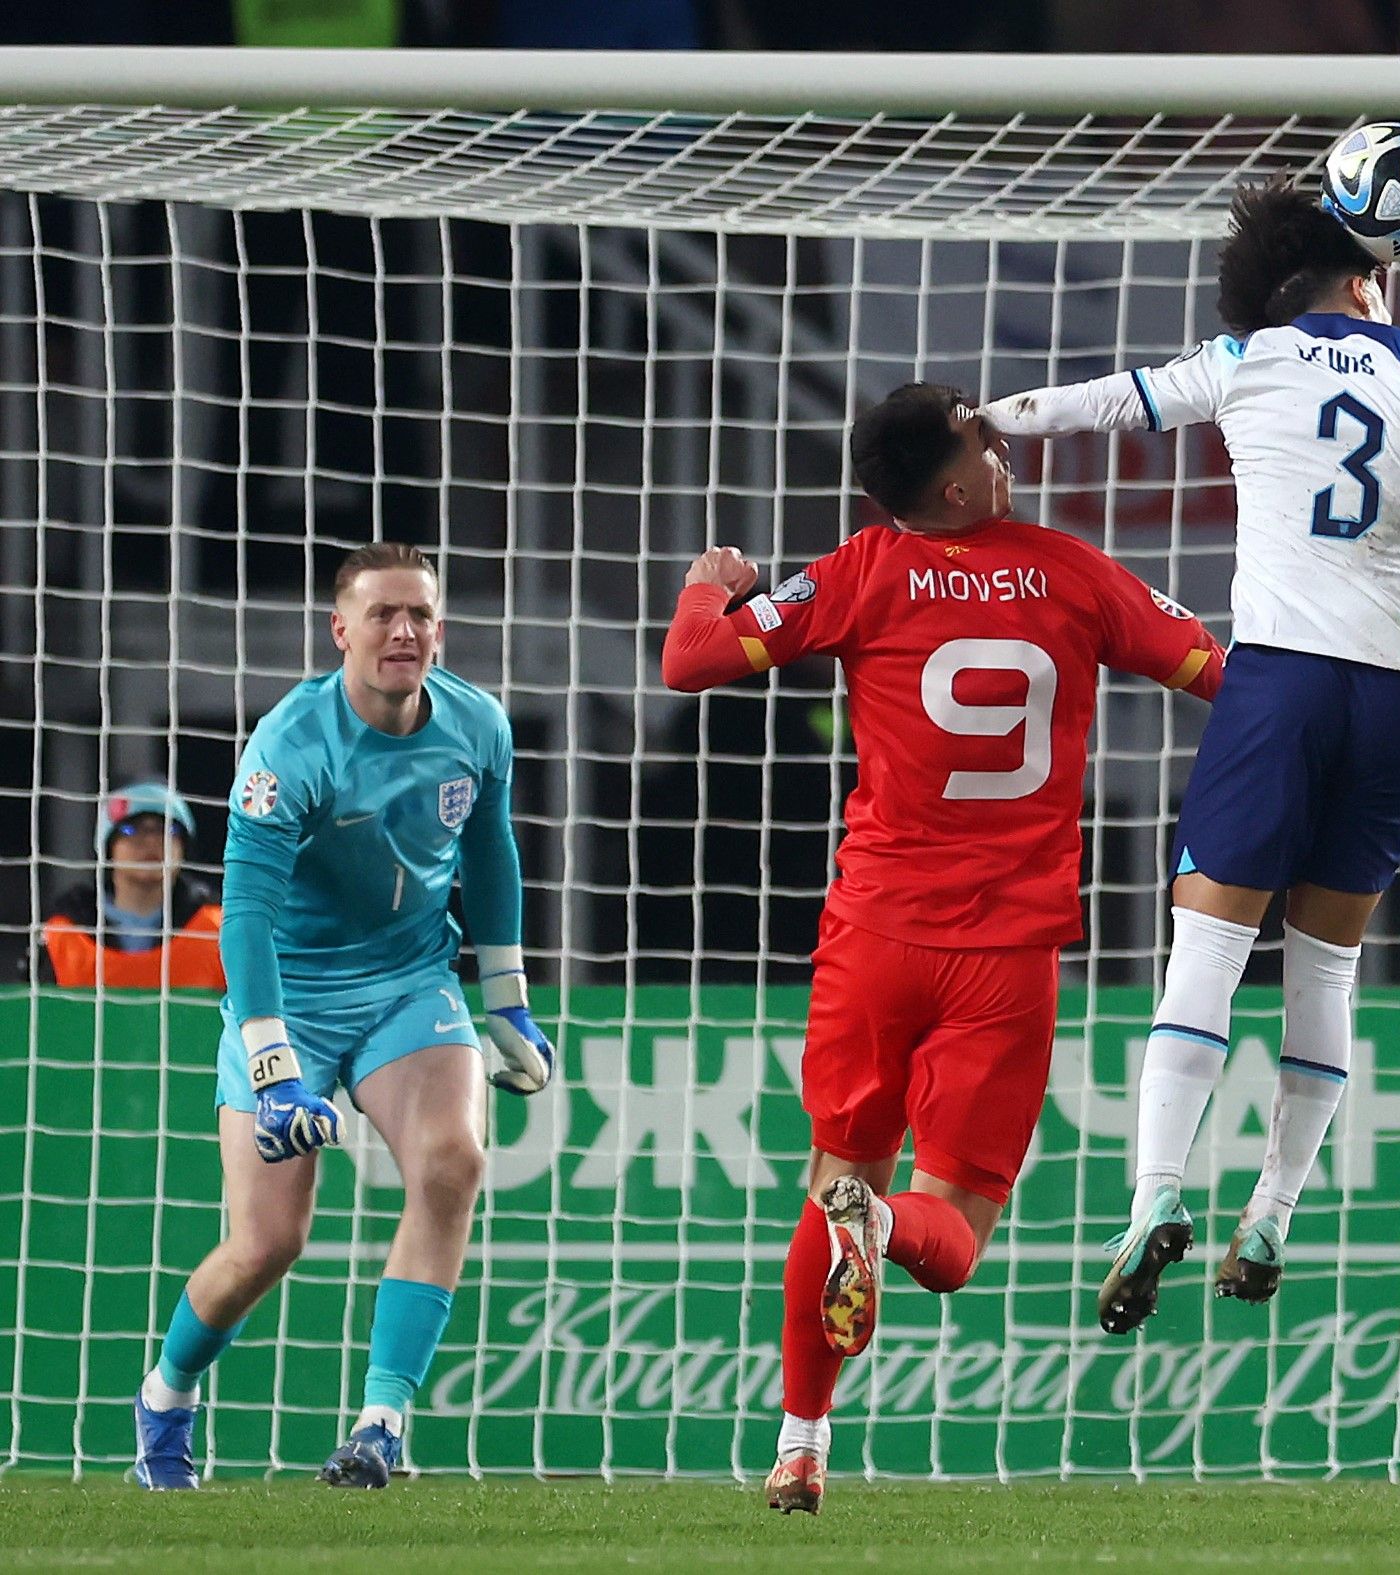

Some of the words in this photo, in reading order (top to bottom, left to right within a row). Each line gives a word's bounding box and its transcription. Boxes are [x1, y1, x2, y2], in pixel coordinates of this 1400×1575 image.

[1310, 388, 1386, 542] 3
[909, 568, 1048, 602] MIOVSKI
[920, 637, 1058, 800] 9
[392, 863, 405, 912] 1
